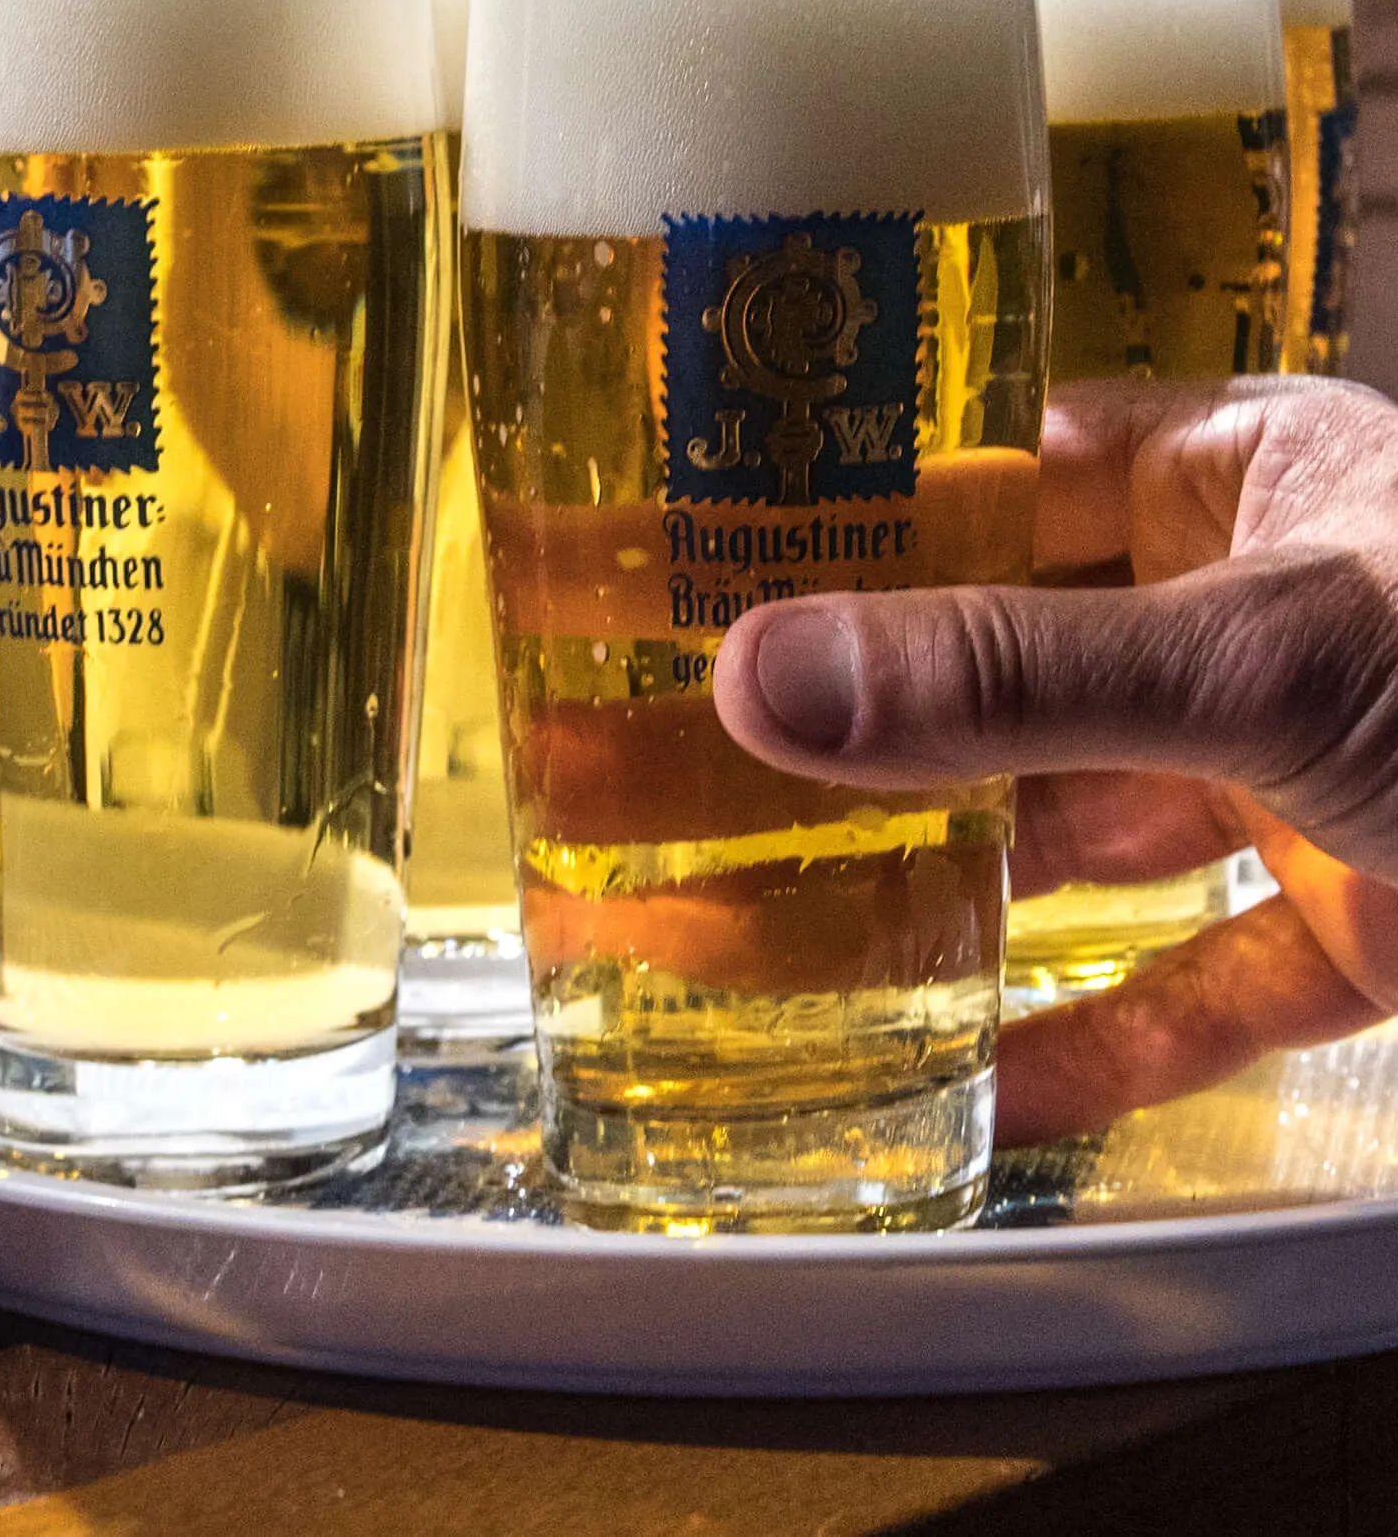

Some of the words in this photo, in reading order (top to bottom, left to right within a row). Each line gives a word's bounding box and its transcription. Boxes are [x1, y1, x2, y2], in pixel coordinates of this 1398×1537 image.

[57, 381, 142, 439] W.
[823, 403, 902, 464] W.
[96, 608, 165, 646] 1328
